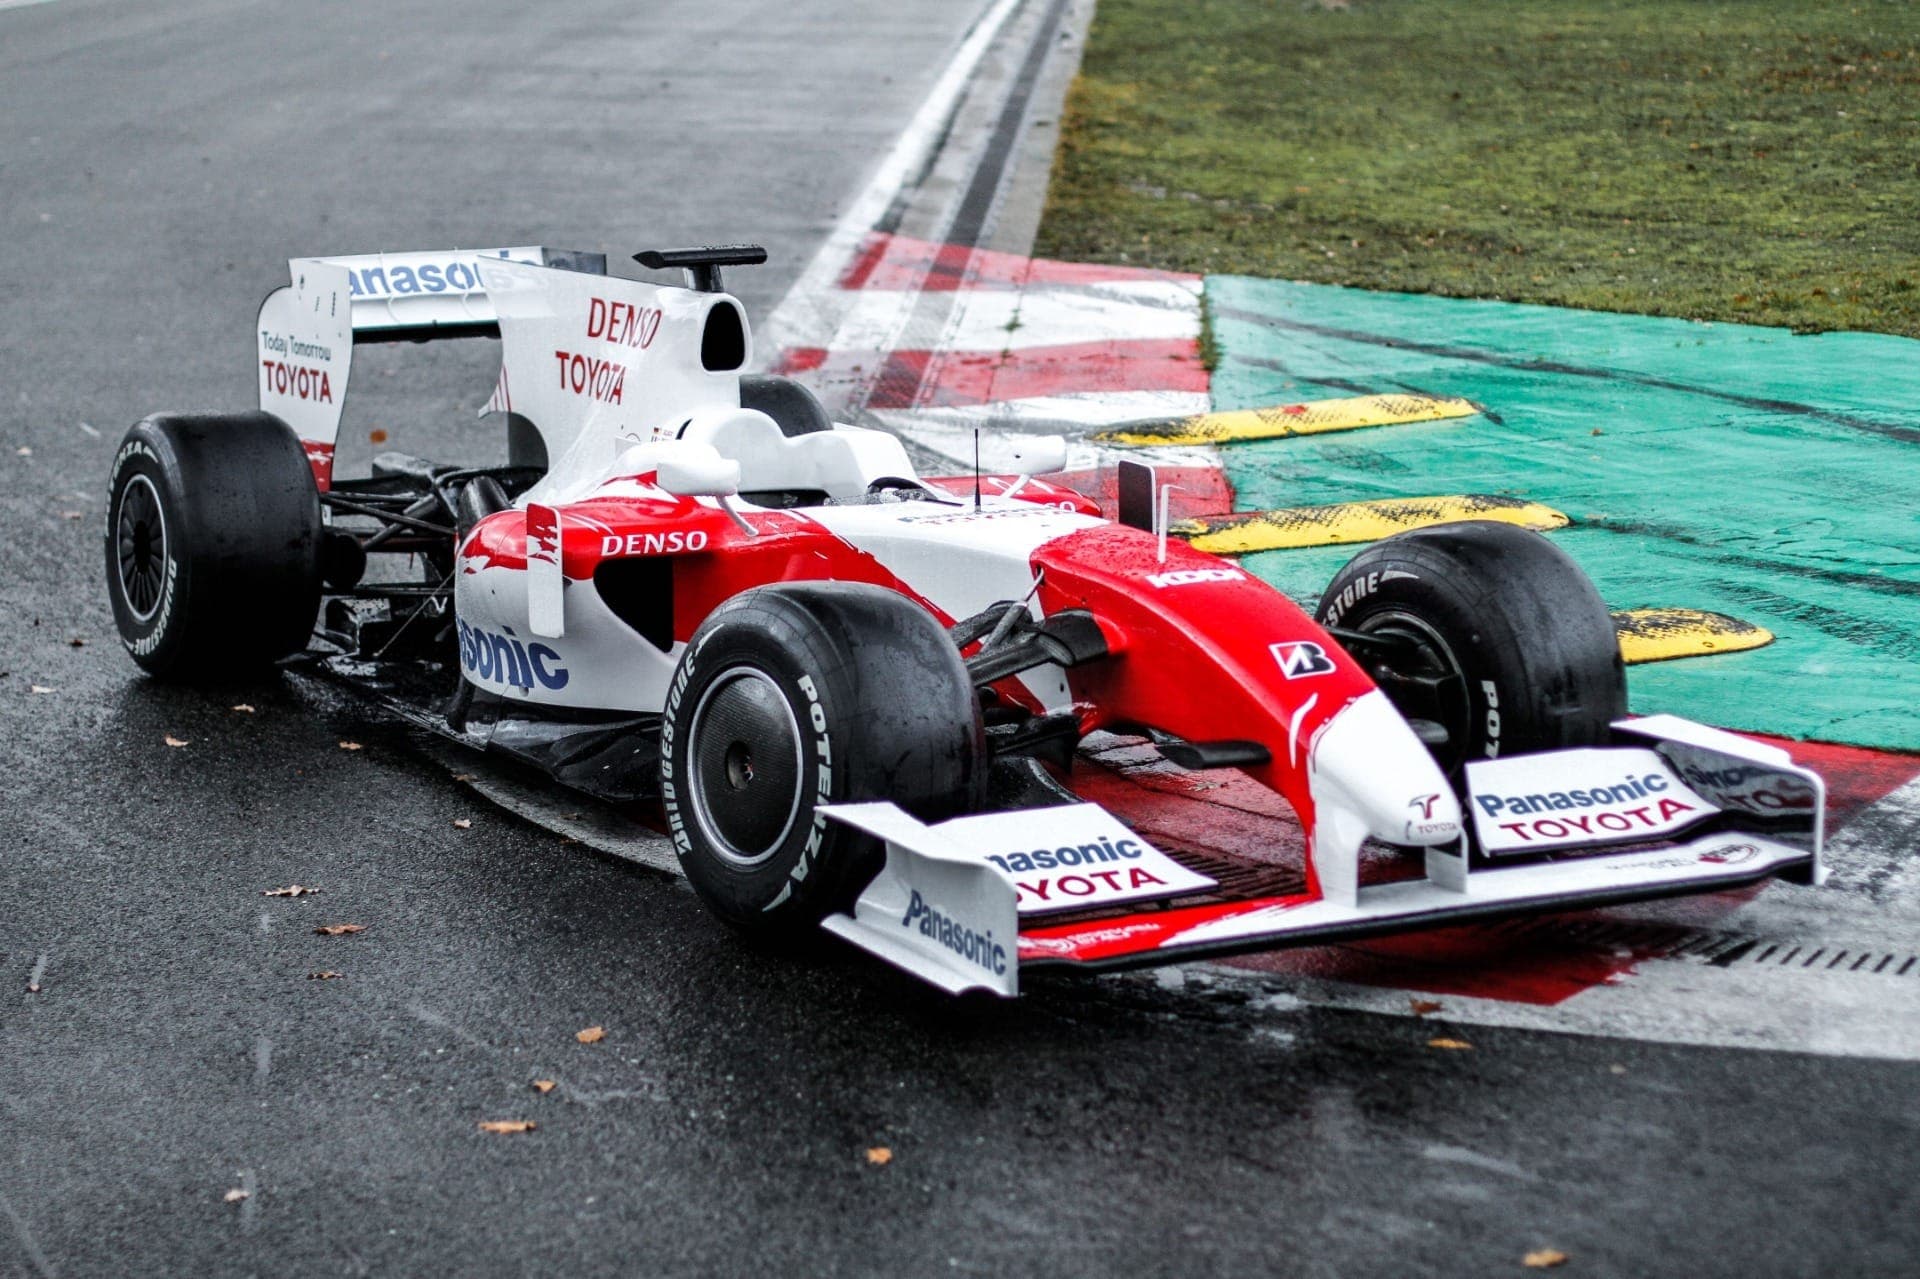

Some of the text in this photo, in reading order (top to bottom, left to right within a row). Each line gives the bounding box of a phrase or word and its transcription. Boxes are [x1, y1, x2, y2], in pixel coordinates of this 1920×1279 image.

[588, 297, 662, 349] DENSO
[262, 331, 331, 361] Today Tomorrow
[263, 360, 332, 404] TOYOTA
[556, 350, 627, 405] TOYOTA
[601, 531, 708, 556] DENSO
[1144, 568, 1248, 588] KDDI
[456, 614, 569, 690] sonic
[662, 650, 696, 855] BRIDGESTONE
[1475, 773, 1669, 817] Panasonic
[1417, 822, 1457, 834] TOYOTA
[1499, 798, 1696, 840] TOYOTA
[985, 836, 1142, 873] nasonic
[1016, 867, 1168, 903] YOTA
[902, 889, 1006, 977] Panasonic
